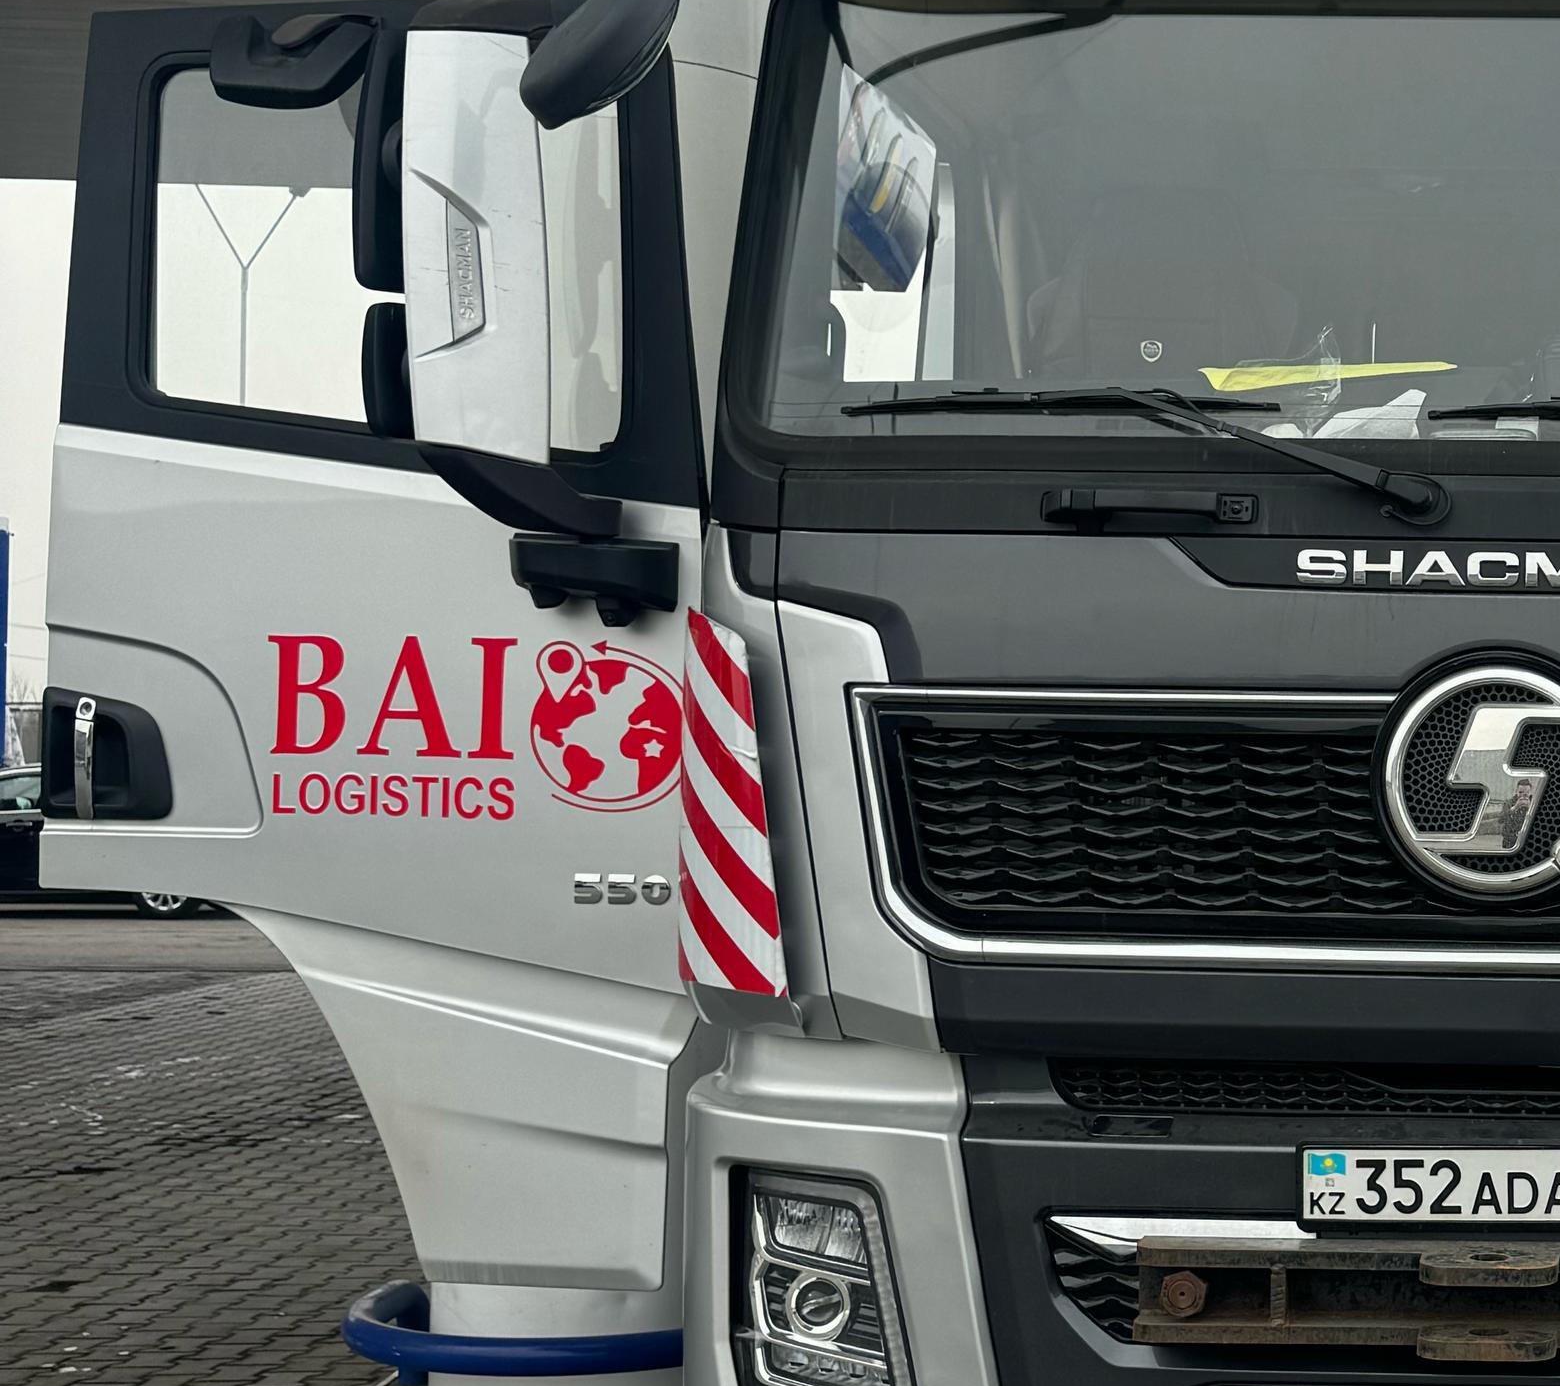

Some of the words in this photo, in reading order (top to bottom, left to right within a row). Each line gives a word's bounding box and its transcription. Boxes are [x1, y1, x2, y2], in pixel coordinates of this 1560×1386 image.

[454, 227, 474, 320] SHACMAN
[267, 634, 518, 761] BAI
[271, 773, 516, 821] LOGISTICS
[574, 873, 671, 905] 550
[1310, 1191, 1346, 1215] KZ
